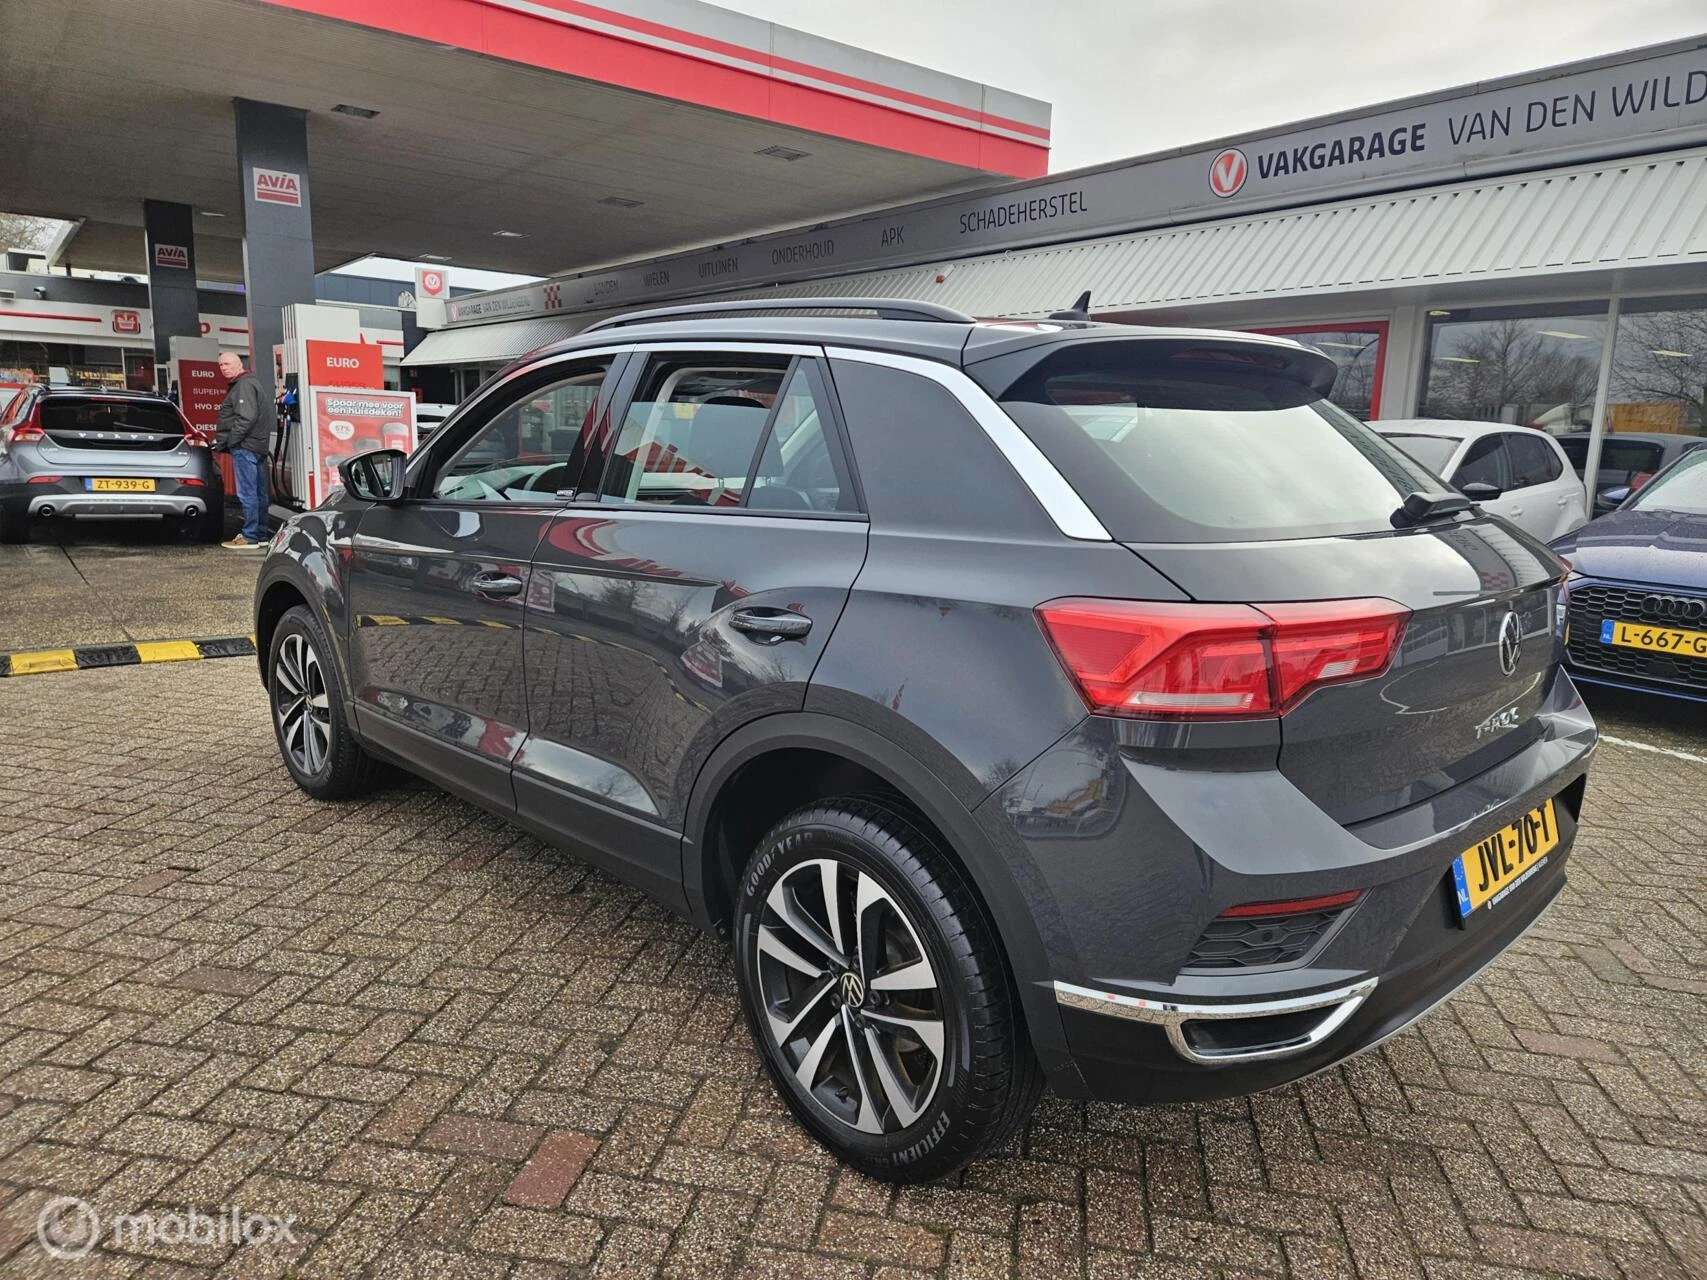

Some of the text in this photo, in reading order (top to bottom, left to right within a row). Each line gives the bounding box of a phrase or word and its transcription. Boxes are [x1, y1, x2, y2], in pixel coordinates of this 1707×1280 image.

[1258, 70, 1707, 179] VAKGARAGE VAN DEN WILD
[959, 190, 1088, 234] SCHADEHERSTEL
[881, 227, 905, 247] APK
[771, 239, 835, 265] ONDERHOUD
[326, 357, 360, 369] EURO
[191, 370, 215, 378] EURO
[327, 399, 356, 408] Spaar
[78, 432, 154, 440] VOLVO
[97, 479, 150, 489] ZT-939-G
[1620, 626, 1707, 653] L-667-G
[1457, 888, 1468, 904] NL
[1477, 802, 1550, 892] JVL-70-T
